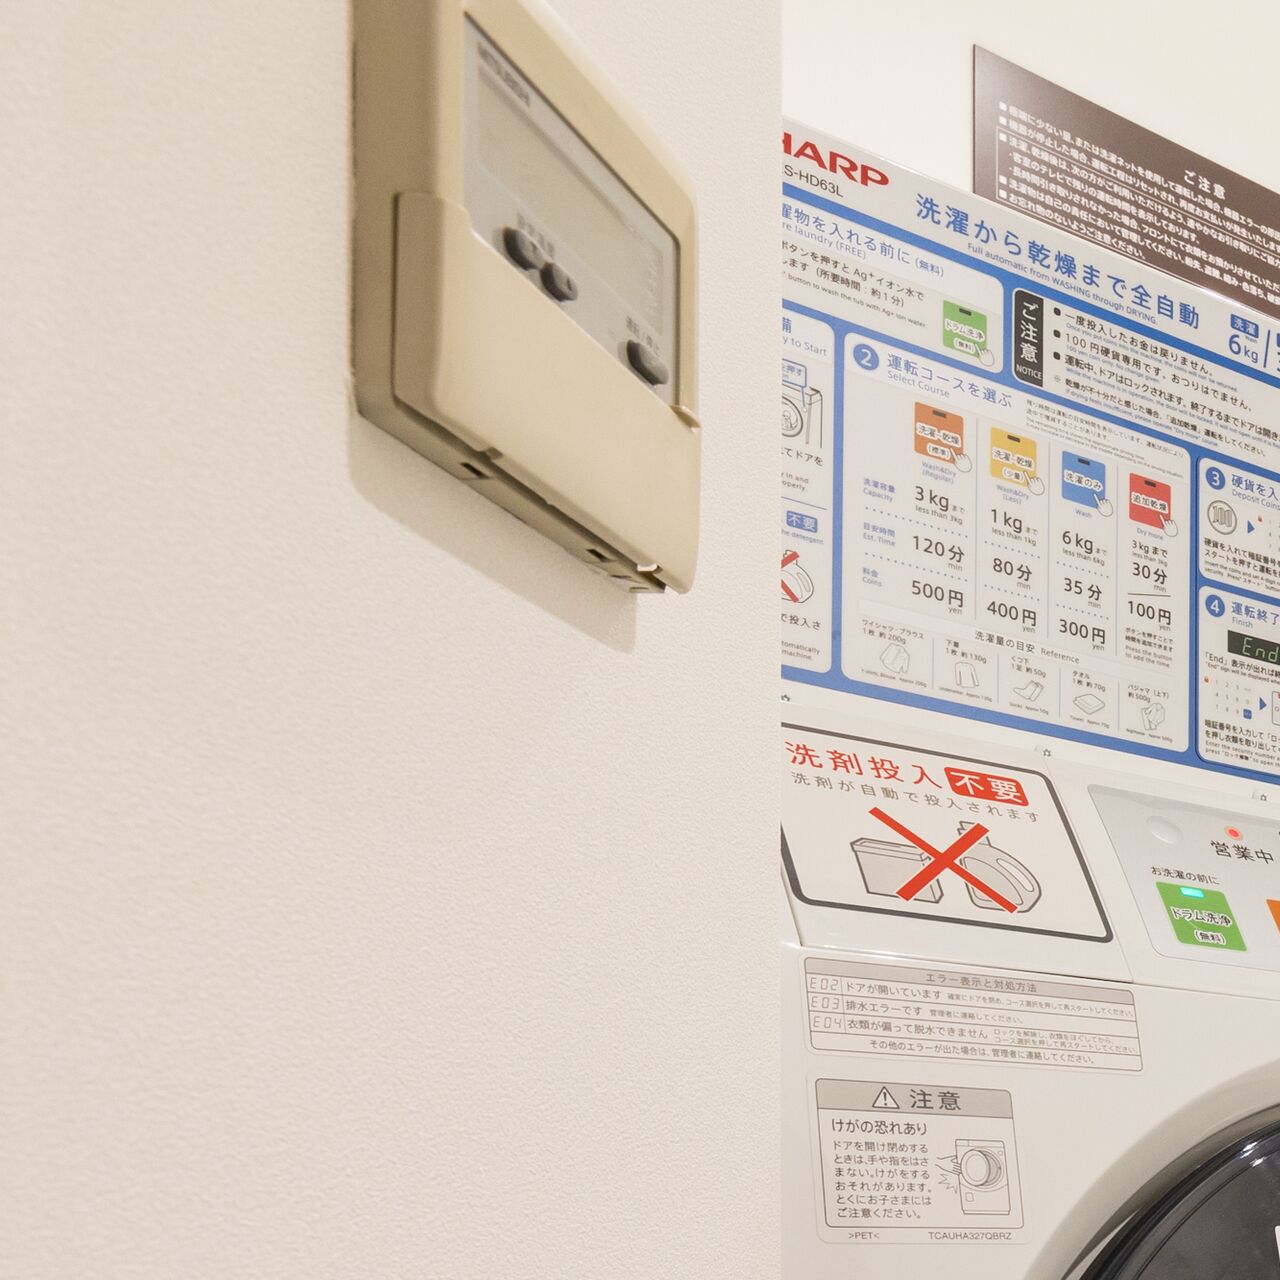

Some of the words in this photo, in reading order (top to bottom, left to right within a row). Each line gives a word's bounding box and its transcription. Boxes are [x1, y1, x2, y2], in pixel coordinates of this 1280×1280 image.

[783, 132, 890, 187] ARP
[784, 164, 843, 198] S-HD63L
[1184, 167, 1225, 201] ご注意
[916, 190, 1199, 331] 洗濯から乾燥まで全自動
[967, 241, 982, 256] Full
[985, 248, 1027, 274] automatic
[1029, 266, 1049, 283] from
[1051, 275, 1090, 299] WASHING
[1092, 291, 1123, 313] through
[1126, 305, 1156, 326] DRYING.
[1019, 296, 1038, 365] ご注意
[1233, 315, 1256, 337] 洗濯
[1065, 309, 1212, 378] 一度投入したお金は戻りません。
[887, 352, 1011, 409] 運転コースを選ぶ
[1016, 363, 1042, 381] NOTICE
[887, 370, 914, 387] Select
[917, 380, 949, 399] Course
[1232, 488, 1257, 504] Deposit
[1261, 498, 1280, 512] Coins
[786, 510, 817, 533] 不要
[913, 533, 964, 564] 120分
[992, 556, 1031, 583] 80分
[1128, 599, 1170, 625] 100円
[1132, 561, 1166, 586] 30分
[912, 579, 963, 608] 500円
[987, 599, 1036, 627] 400円
[1059, 618, 1105, 645] 300円
[1231, 600, 1279, 627] 運転終了
[1232, 616, 1253, 628] Finish
[975, 629, 1034, 653] 洗濯量の目安
[1040, 647, 1079, 664] Reference
[1242, 635, 1278, 663] End
[785, 741, 943, 789] 洗剤投入
[951, 771, 1024, 803] 不要
[791, 771, 1041, 823] 洗剤が自動で投入されます
[1211, 840, 1275, 866] 営業中
[1150, 864, 1218, 885] お洗濯の前に
[1171, 906, 1232, 928] ドラム洗浄
[845, 982, 942, 1000] ドアが開いています
[925, 972, 1037, 992] エラー表示と対処方法
[845, 1000, 922, 1016] 排水エラーです
[847, 1019, 987, 1039] 衣類が偏って脱水できません
[909, 1088, 961, 1110] 注意
[831, 1118, 927, 1136] けがの恐れあり
[833, 1140, 928, 1153] ドアを開け閉めする
[833, 1154, 929, 1166] ときは、手や指をはさ
[834, 1168, 930, 1179] まない。けがをする
[835, 1181, 932, 1193] おそれがあります。
[836, 1194, 931, 1205] とくにお子さまには
[837, 1208, 921, 1218] ご注意ください。
